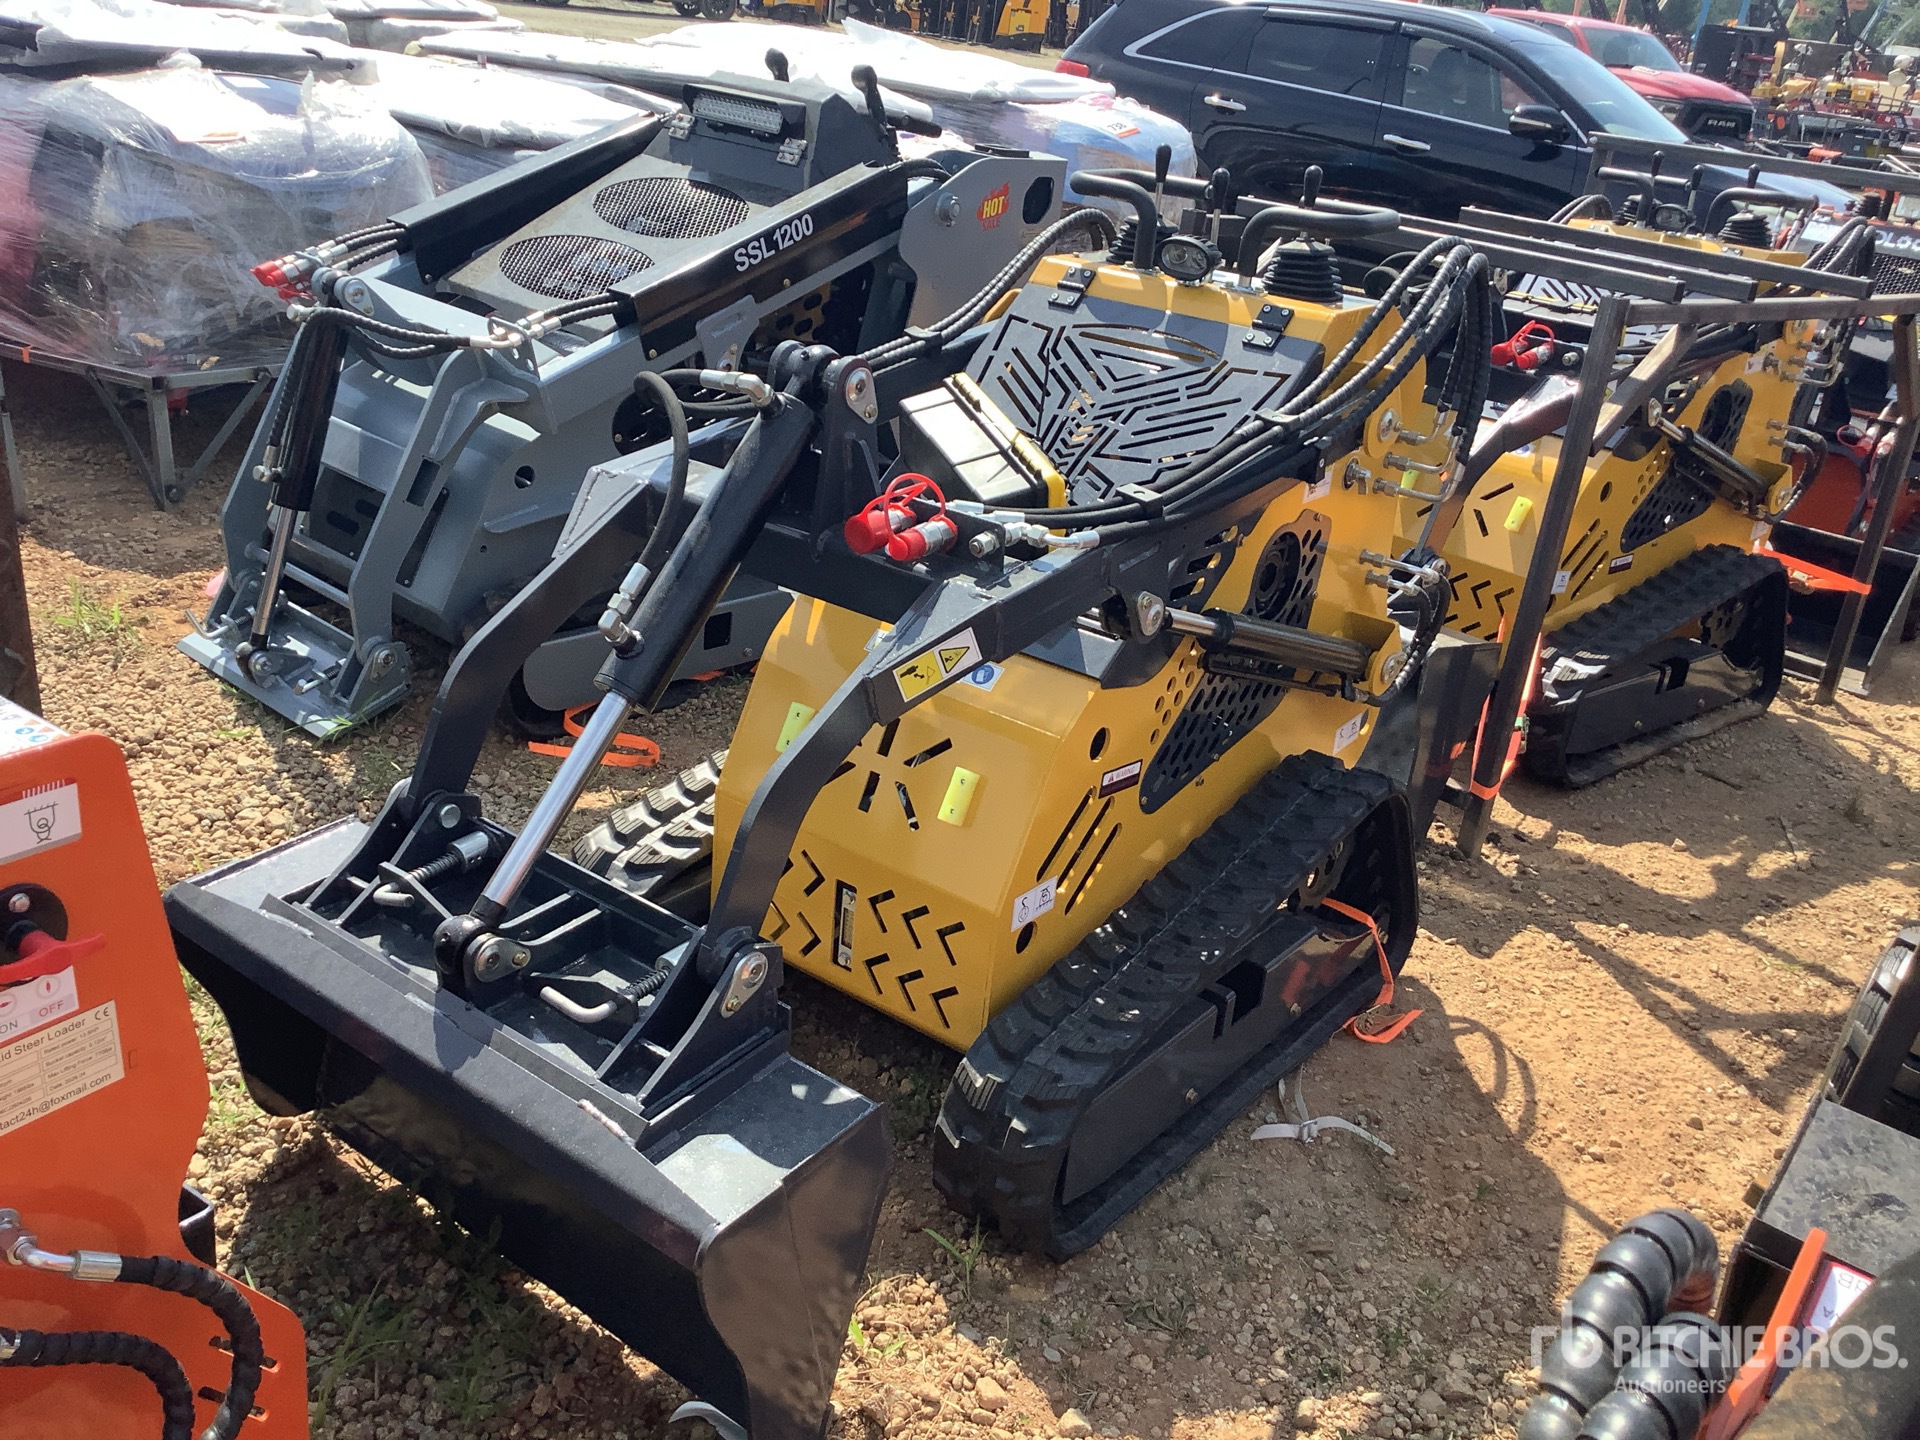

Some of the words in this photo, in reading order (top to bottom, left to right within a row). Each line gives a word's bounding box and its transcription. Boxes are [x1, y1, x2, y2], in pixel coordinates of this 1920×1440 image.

[1707, 119, 1736, 128] RAM
[982, 195, 1005, 219] HOT
[734, 236, 776, 272] SSL
[772, 213, 814, 251] 1200
[38, 1000, 64, 1018] OFF
[0, 1019, 18, 1034] ON
[0, 1050, 12, 1061] id
[14, 1036, 45, 1055] Steer
[47, 1018, 86, 1042] Loader
[94, 1006, 111, 1021] CE
